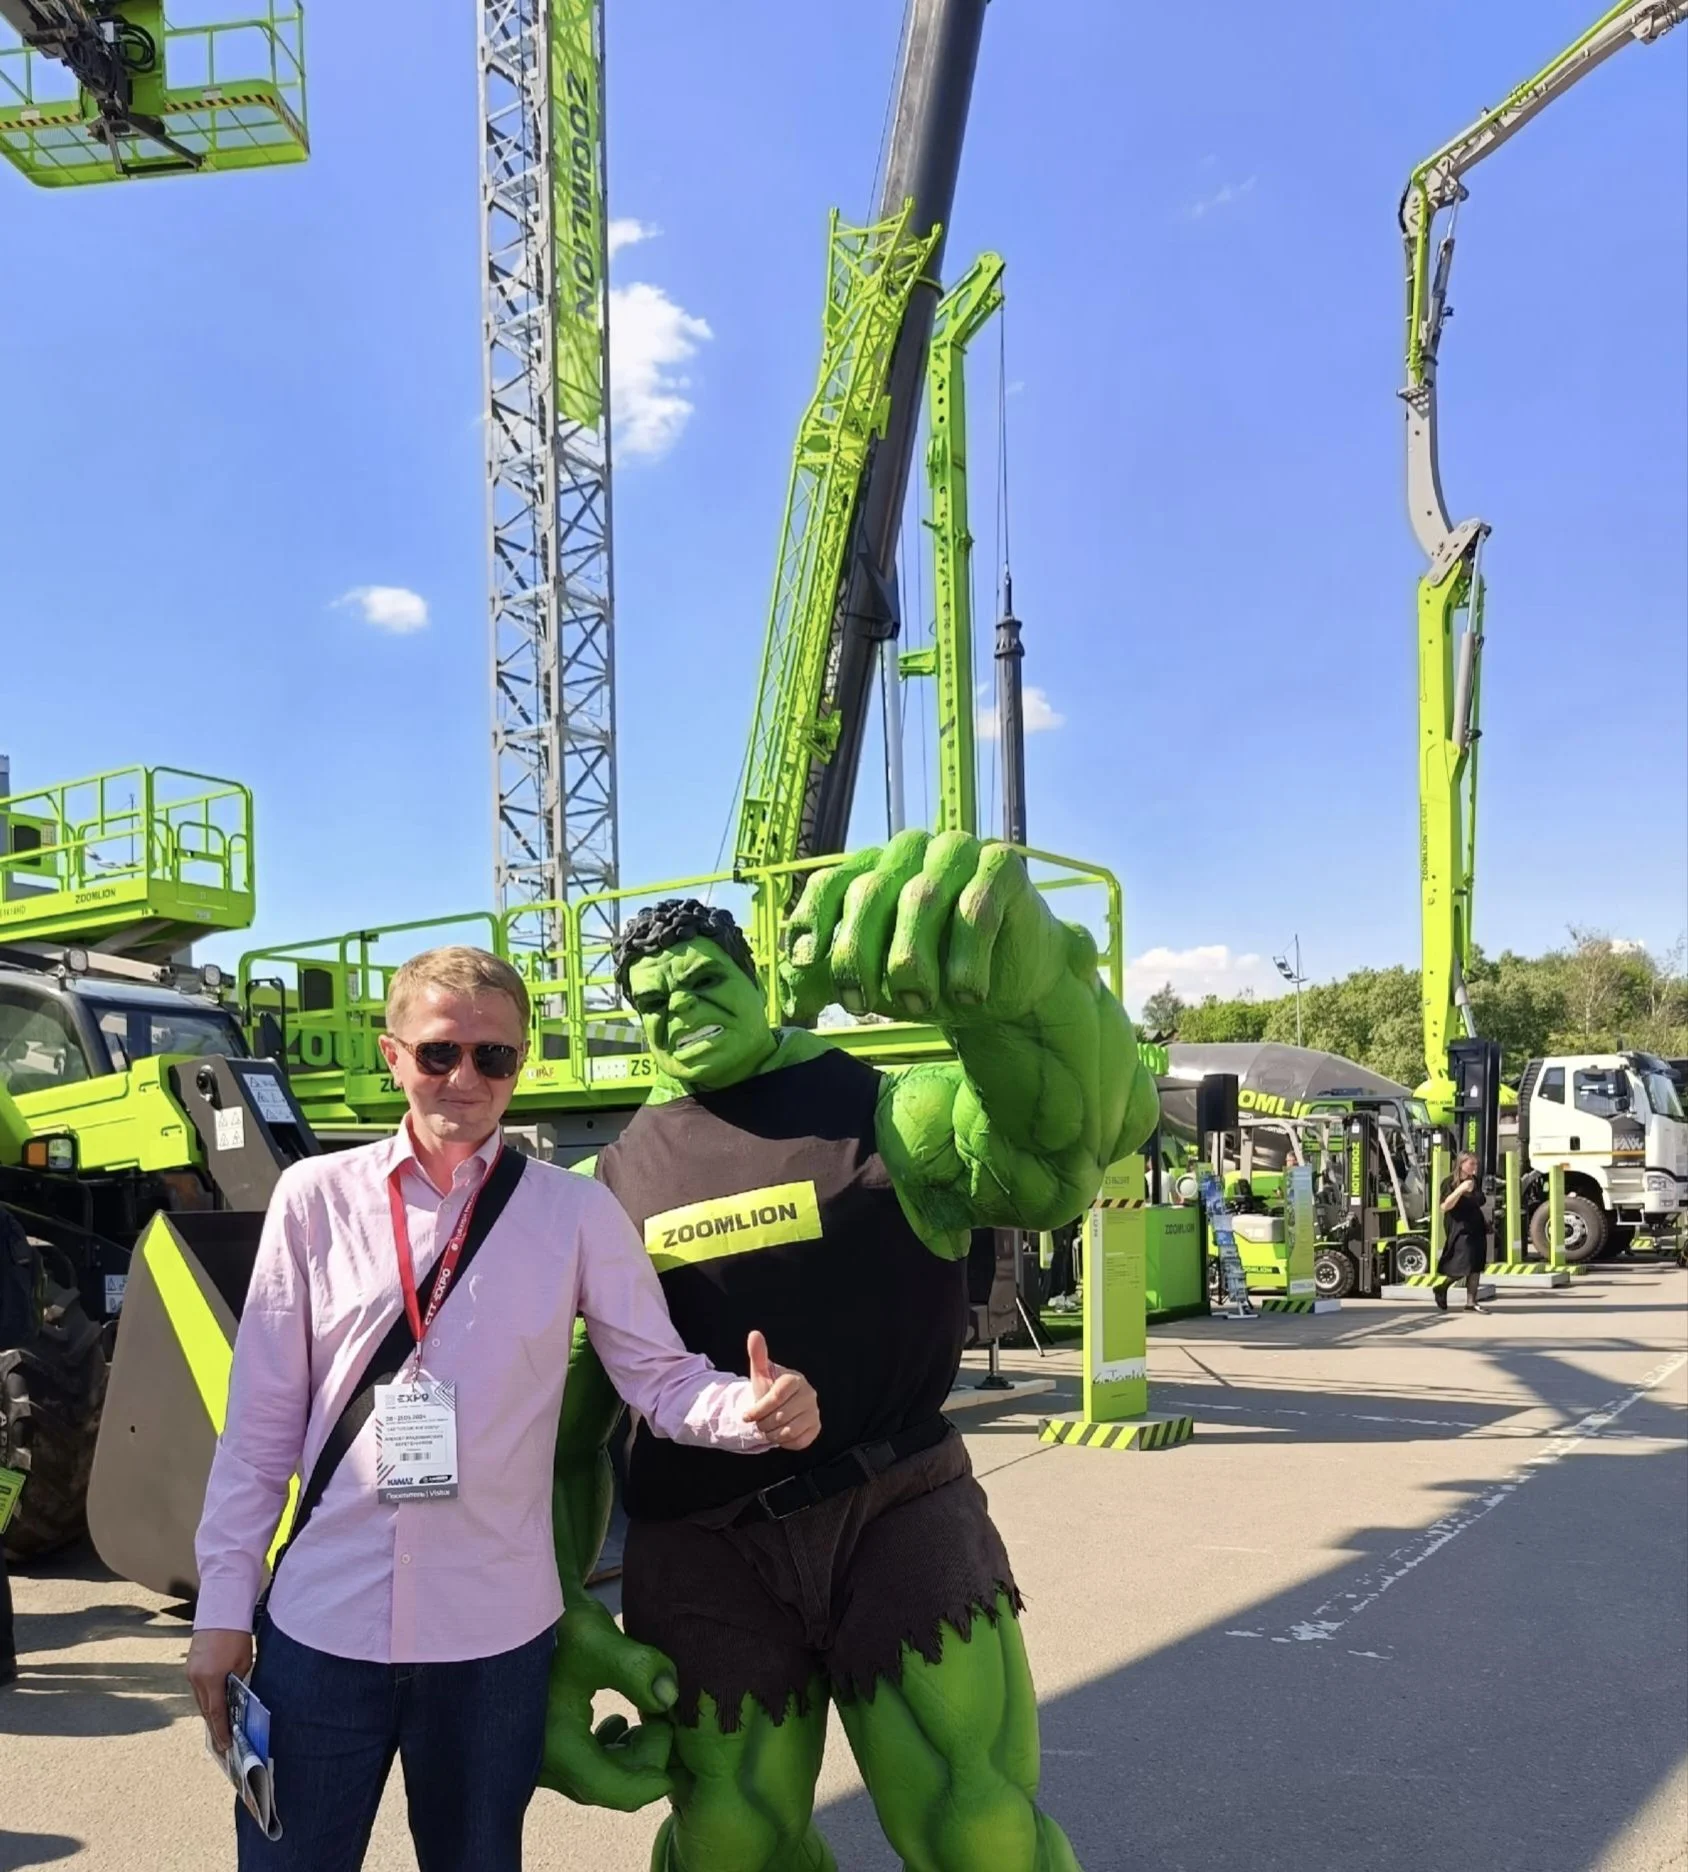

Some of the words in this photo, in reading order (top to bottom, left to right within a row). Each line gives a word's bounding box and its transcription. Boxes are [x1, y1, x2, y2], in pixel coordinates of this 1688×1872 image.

[566, 68, 597, 320] ZOOMLION
[75, 888, 116, 904] ZOOMLION
[1351, 1142, 1360, 1196] ZOOMLION
[662, 1203, 797, 1249] ZOOMLION
[424, 1302, 437, 1326] CTT
[397, 1393, 429, 1403] EXPO
